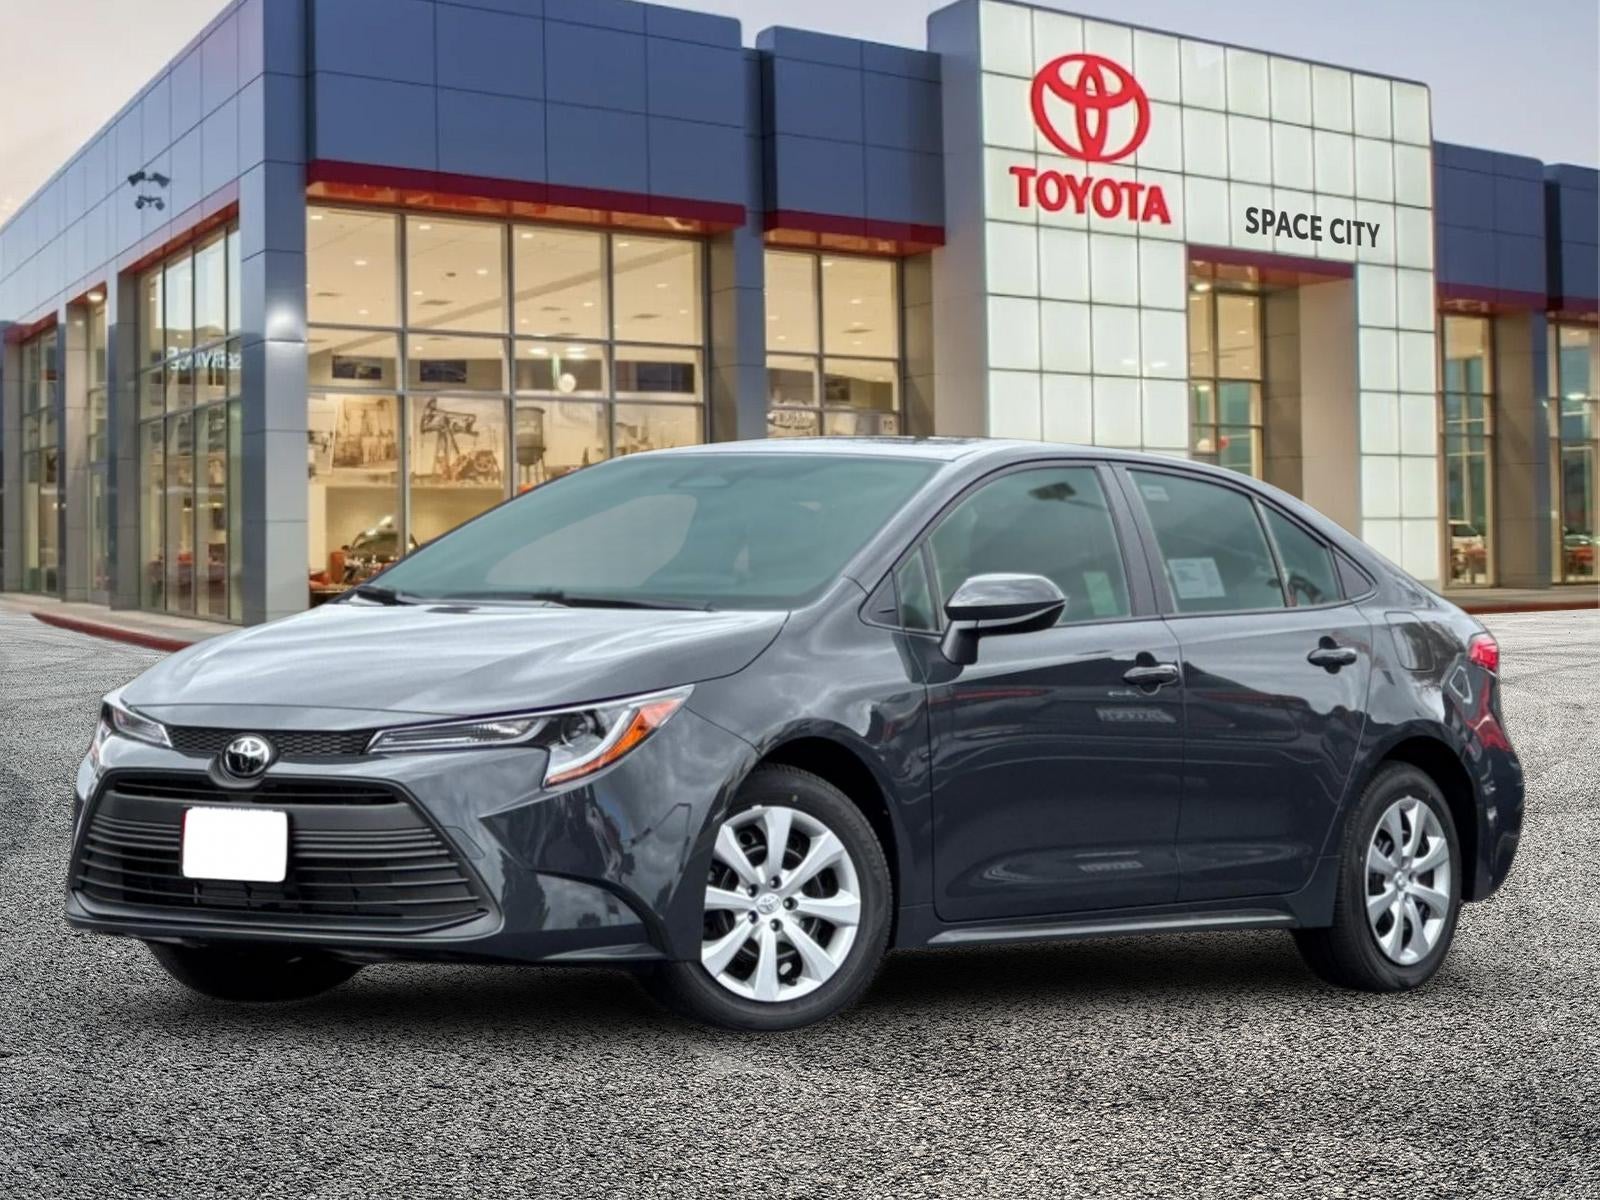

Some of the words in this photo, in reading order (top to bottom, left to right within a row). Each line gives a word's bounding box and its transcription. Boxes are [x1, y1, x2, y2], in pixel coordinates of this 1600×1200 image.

[1009, 166, 1171, 224] TOYOTA
[1245, 207, 1322, 242] SPACE
[1329, 218, 1380, 248] CITY
